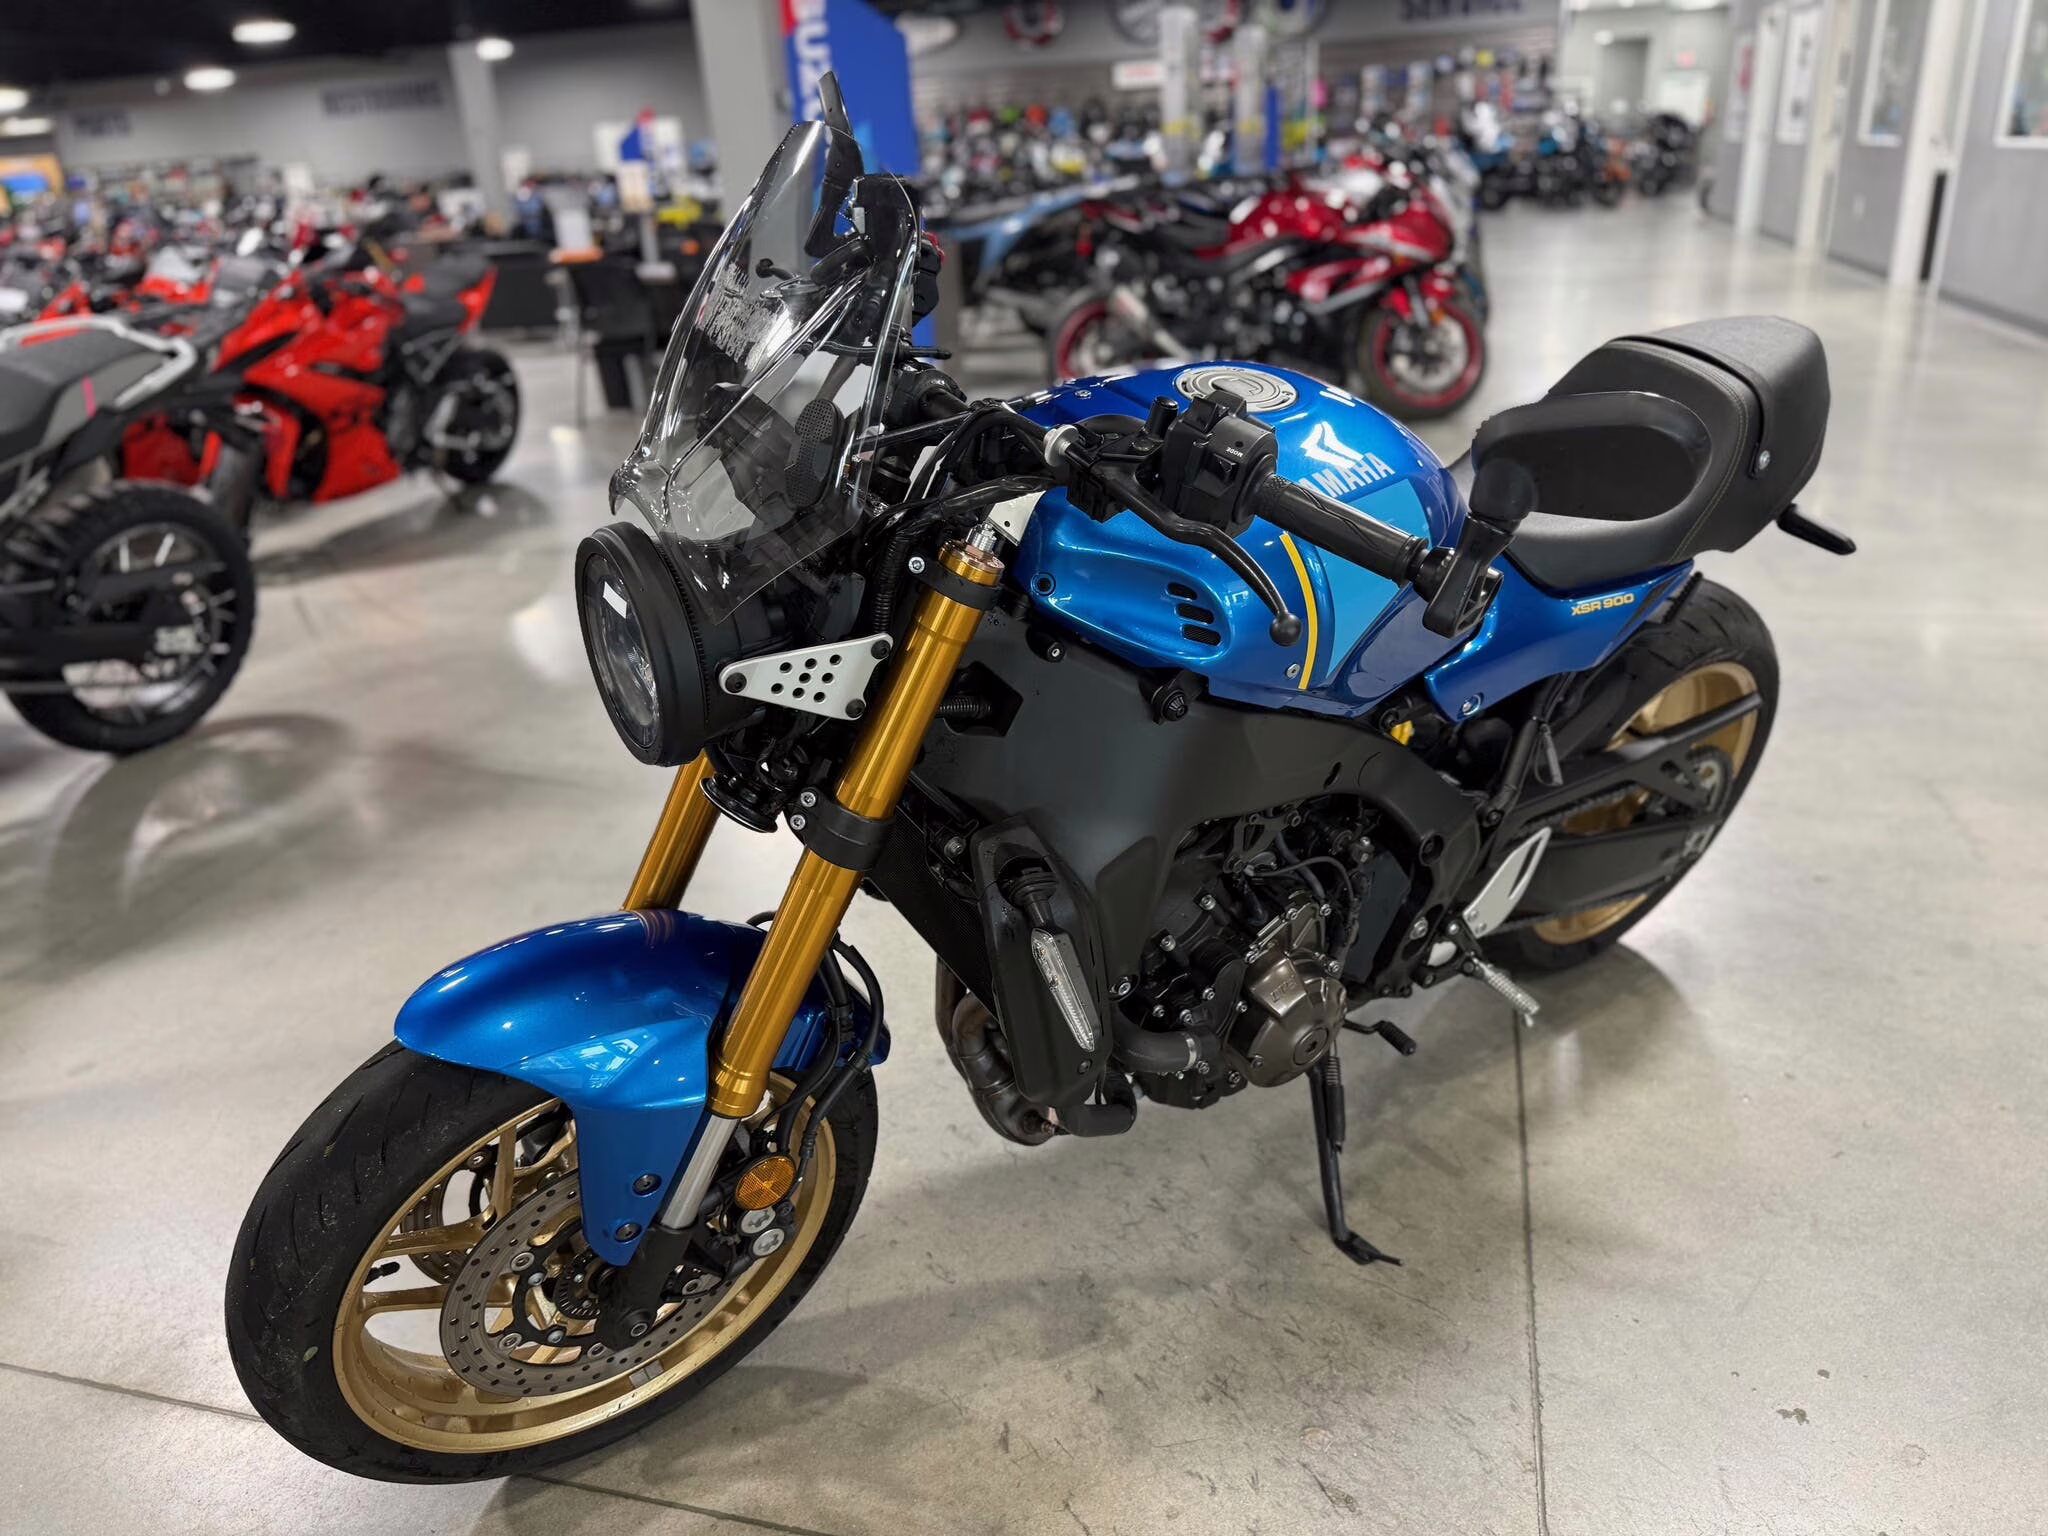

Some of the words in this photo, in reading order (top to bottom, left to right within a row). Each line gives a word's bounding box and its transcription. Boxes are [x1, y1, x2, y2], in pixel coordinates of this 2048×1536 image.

[1226, 446, 1244, 458] MODE
[1299, 451, 1397, 499] AMAHA
[1571, 601, 1602, 616] XSR
[1603, 593, 1635, 609] 900
